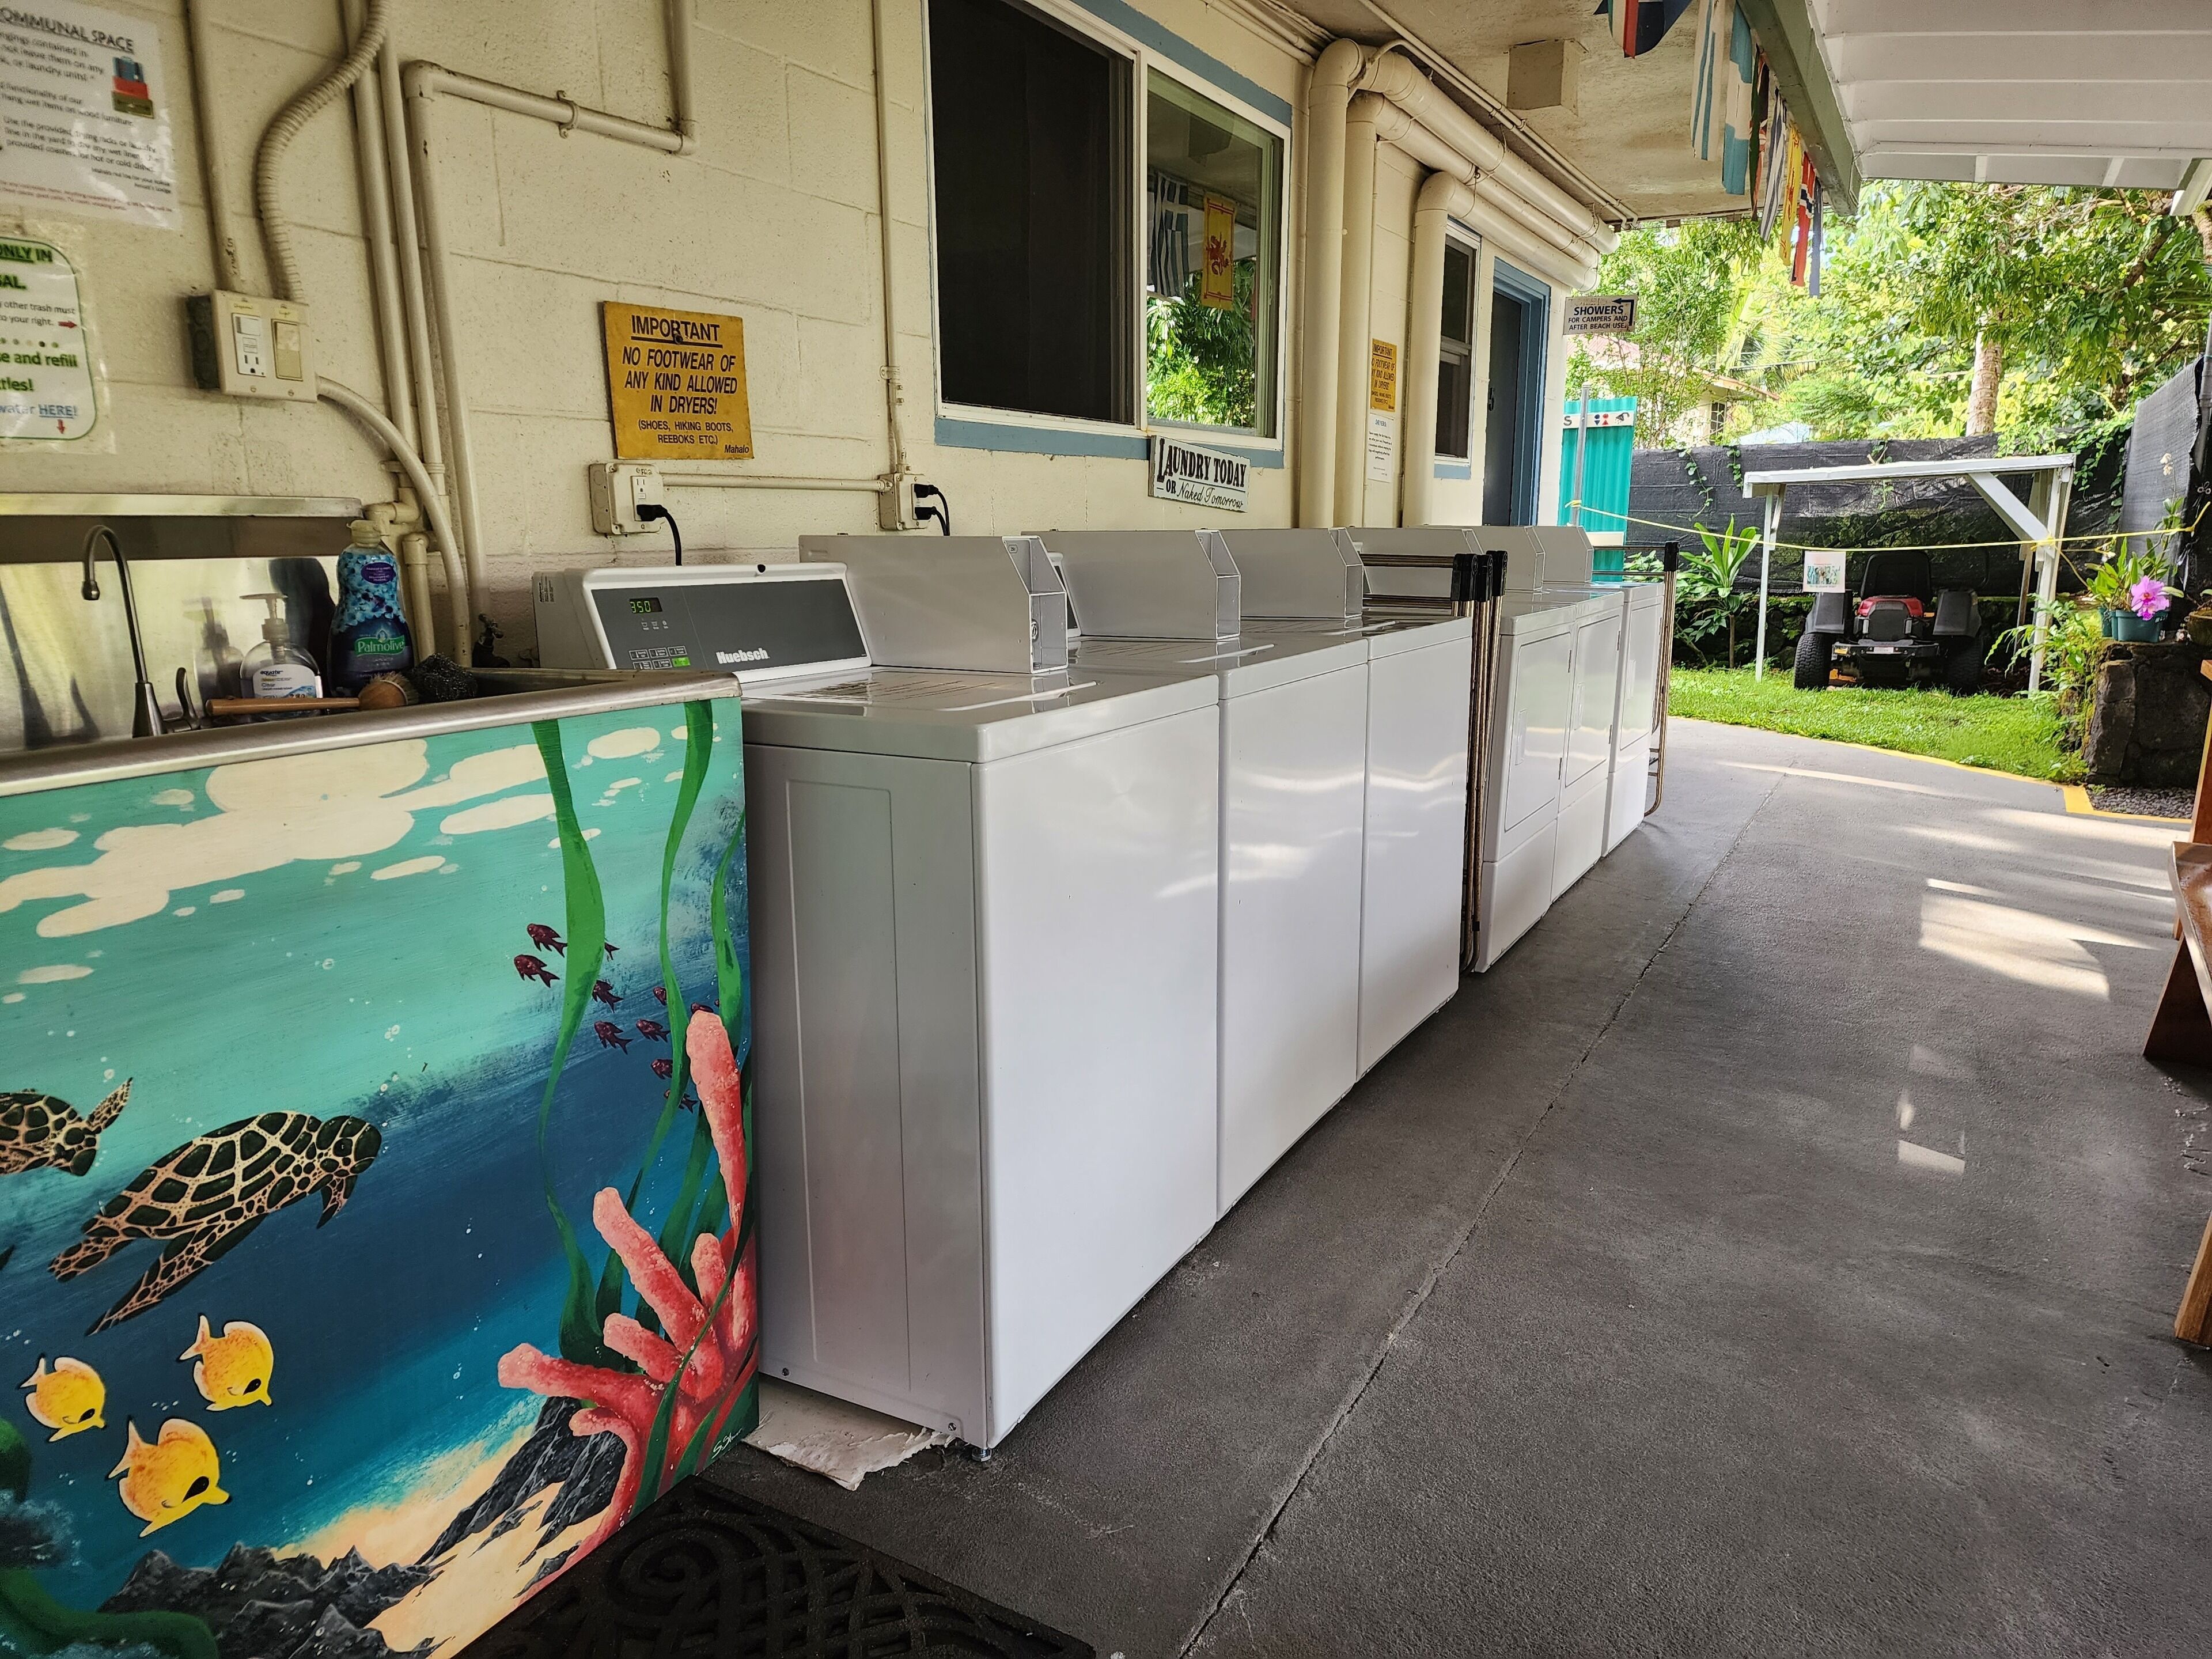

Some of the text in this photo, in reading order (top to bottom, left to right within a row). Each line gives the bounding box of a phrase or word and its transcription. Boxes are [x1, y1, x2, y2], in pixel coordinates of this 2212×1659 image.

[0, 7, 134, 51] OMMUNAL SPACE
[4, 301, 75, 314] other trash must
[1574, 305, 1624, 316] SHOWERS
[9, 316, 28, 324] your
[631, 315, 720, 341] IMPORTANT
[1373, 344, 1393, 357] IMPORTANT
[14, 352, 41, 365] and
[45, 354, 78, 368] refill
[622, 346, 736, 372] NO FOOTWEAR OF
[624, 370, 738, 395] ANY KIND ALLOWED
[38, 404, 78, 416] HERE!
[650, 394, 718, 415] IN DRYERS!
[638, 419, 734, 433] (SHOES, HIKING BOOTS,
[658, 434, 718, 445] REEBOKS ETC.)
[724, 444, 750, 454] Mahalo
[1157, 438, 1247, 487] LAUNDRY TODAY
[1166, 479, 1244, 509] OR Naked Tomorrow
[630, 601, 651, 613] 350
[358, 641, 404, 653] Palmolive
[716, 647, 768, 664] Huebsch
